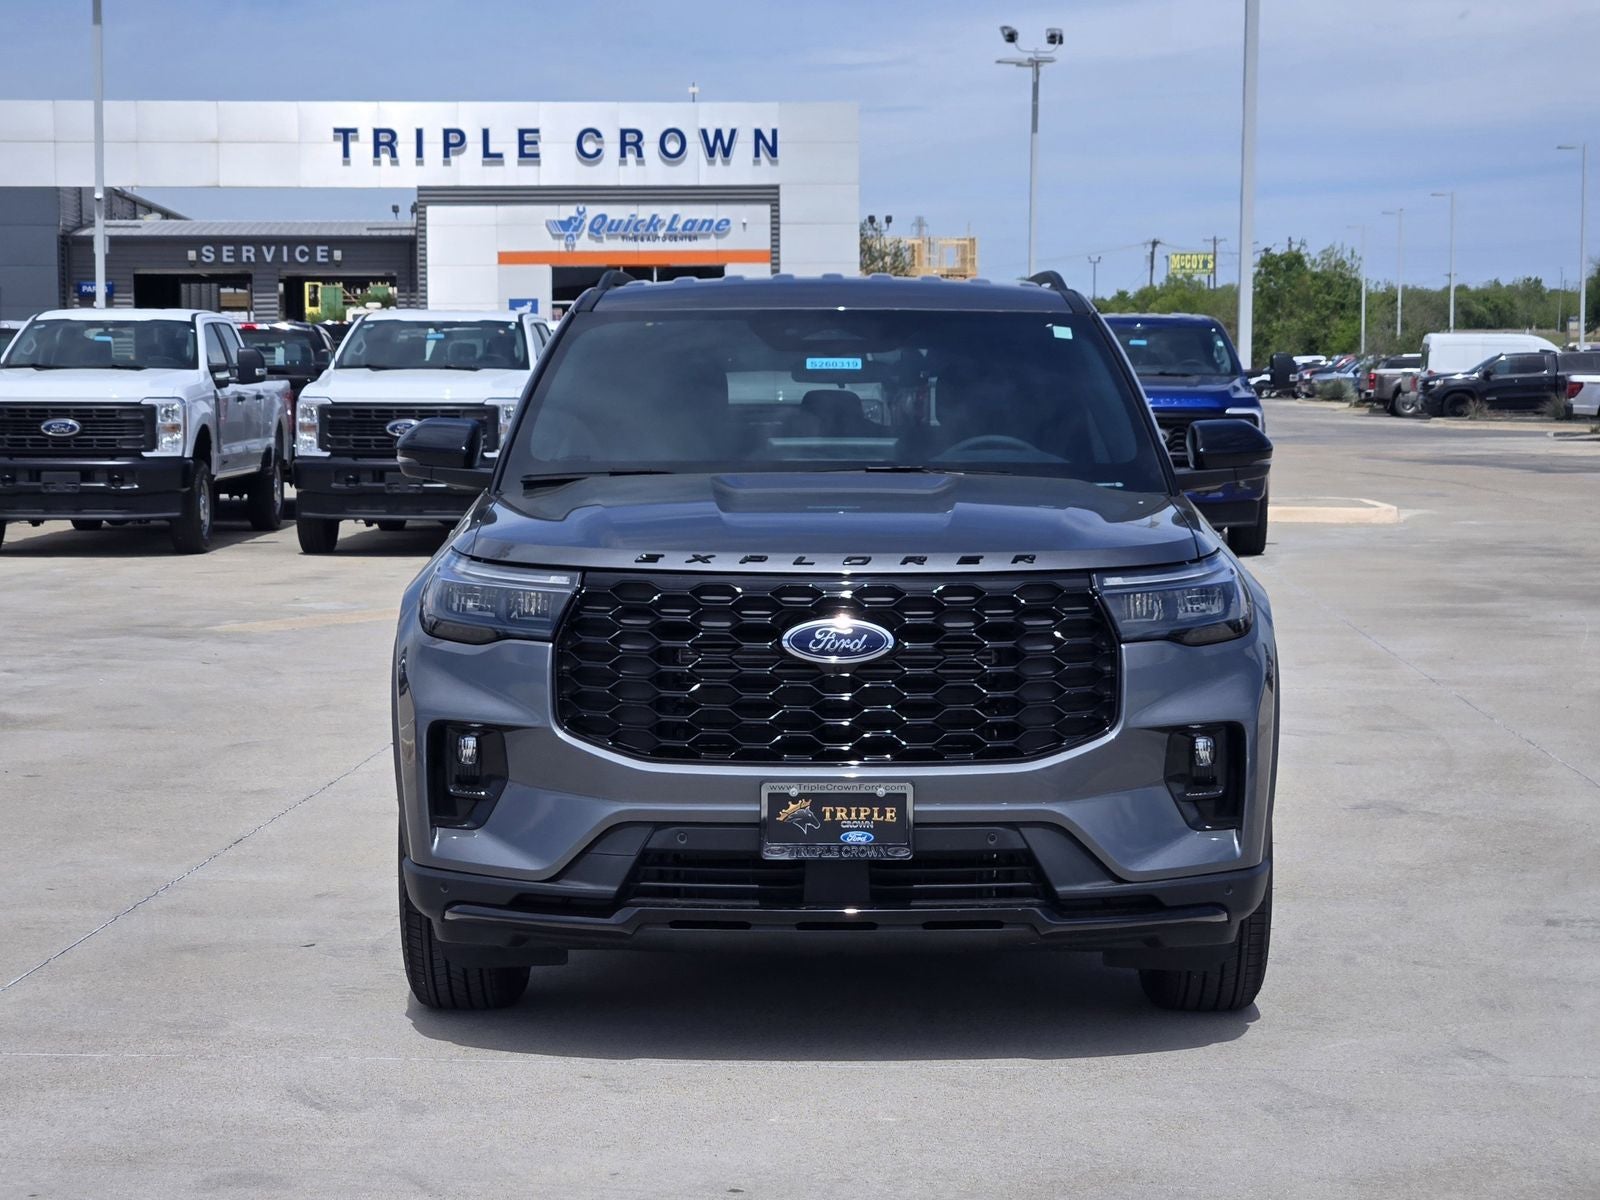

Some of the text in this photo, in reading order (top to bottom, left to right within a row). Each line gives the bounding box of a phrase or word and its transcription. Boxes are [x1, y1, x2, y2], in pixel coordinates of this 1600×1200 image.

[333, 127, 779, 164] TRIPLE CROWN
[588, 212, 732, 236] Quick Lane
[201, 245, 331, 263] SERVICE
[82, 285, 108, 293] PARS
[634, 552, 1037, 566] EXPLORER
[808, 627, 868, 652] Ford
[769, 783, 907, 792] wwwTripleCrownFord.com
[822, 806, 897, 822] TRIPLE
[840, 820, 874, 829] CROWN
[841, 846, 887, 858] CROWN
